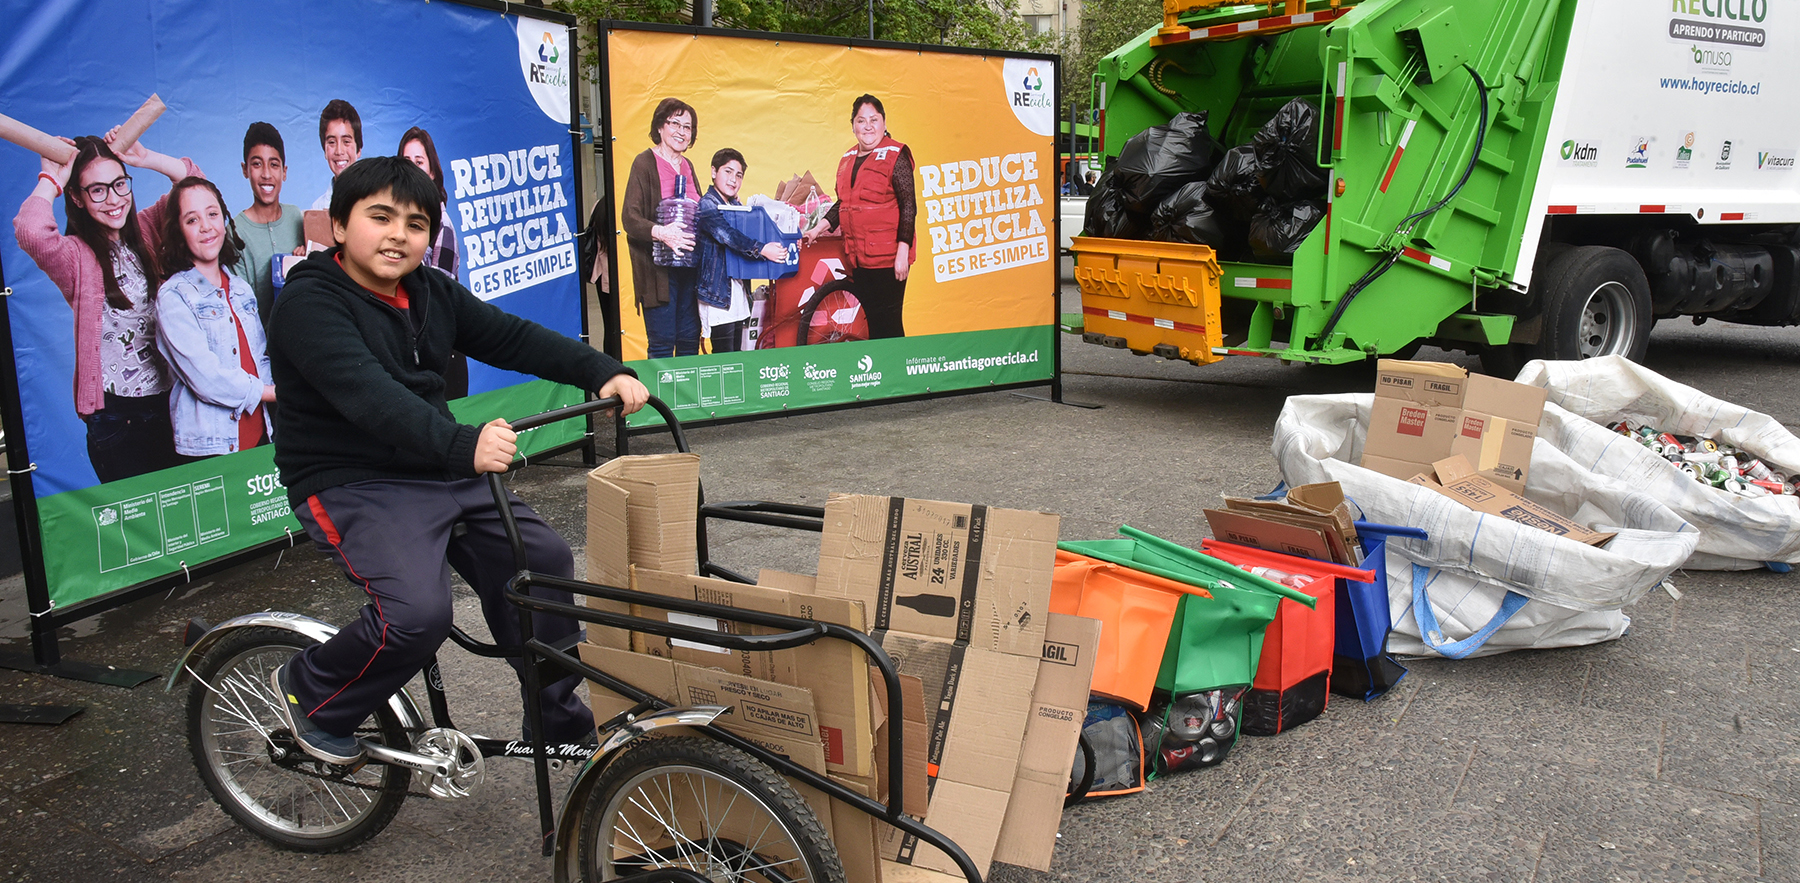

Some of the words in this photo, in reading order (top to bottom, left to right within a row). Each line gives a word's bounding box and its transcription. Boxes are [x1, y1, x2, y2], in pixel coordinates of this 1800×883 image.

[1673, 24, 1714, 38] APRENDO
[1714, 28, 1721, 38] Y
[1722, 30, 1763, 43] PARTICIPO
[1694, 49, 1732, 66] amusa
[1660, 76, 1760, 95] www.hoyreciclo.cl
[1574, 143, 1597, 160] kdm
[1768, 156, 1794, 166] vitacura
[451, 144, 563, 200] REDUCE
[919, 152, 1038, 198] REDUCE
[458, 182, 567, 232] REUTILIZA
[925, 184, 1043, 224] REUTILIZA
[464, 212, 572, 269] RECICLA
[929, 210, 1046, 254] RECICLA
[948, 257, 965, 274] ES
[970, 242, 1044, 270] RE-SIMPLE
[483, 271, 500, 294] ES
[504, 251, 573, 288] RE-SIMPLE
[906, 356, 936, 366] Infórmate
[906, 350, 1038, 375] www.santiagorecicla.cl
[850, 372, 882, 383] SANTIAGO
[1393, 378, 1412, 386] PISAR
[760, 390, 789, 399] SANTIAGO
[1430, 383, 1451, 391] FRAGIL
[1400, 416, 1425, 426] Master
[1402, 408, 1425, 418] Breden
[1465, 417, 1483, 426] Breden
[1464, 423, 1482, 432] Master
[251, 506, 290, 525] SANTIAGO
[901, 540, 909, 570] cerveza
[902, 532, 923, 580] AUSTRAL
[934, 533, 943, 565] UNIDADES
[949, 540, 960, 580] VARIEDADES
[881, 618, 886, 627] LA
[887, 541, 896, 568] AUSTRAL
[931, 567, 945, 584] 24
[1042, 644, 1068, 661] AGIL
[950, 663, 958, 672] Ale
[947, 672, 956, 685] Dark
[721, 686, 746, 696] FRESCO
[752, 693, 770, 701] SECO
[756, 713, 776, 723] CAJAS
[757, 708, 779, 717] APILAR
[1038, 707, 1073, 716] PRODUCTO
[1038, 712, 1073, 722] CONGELADO
[937, 720, 946, 729] Ale
[935, 729, 944, 740] Pale
[394, 758, 422, 768] VUELTA
